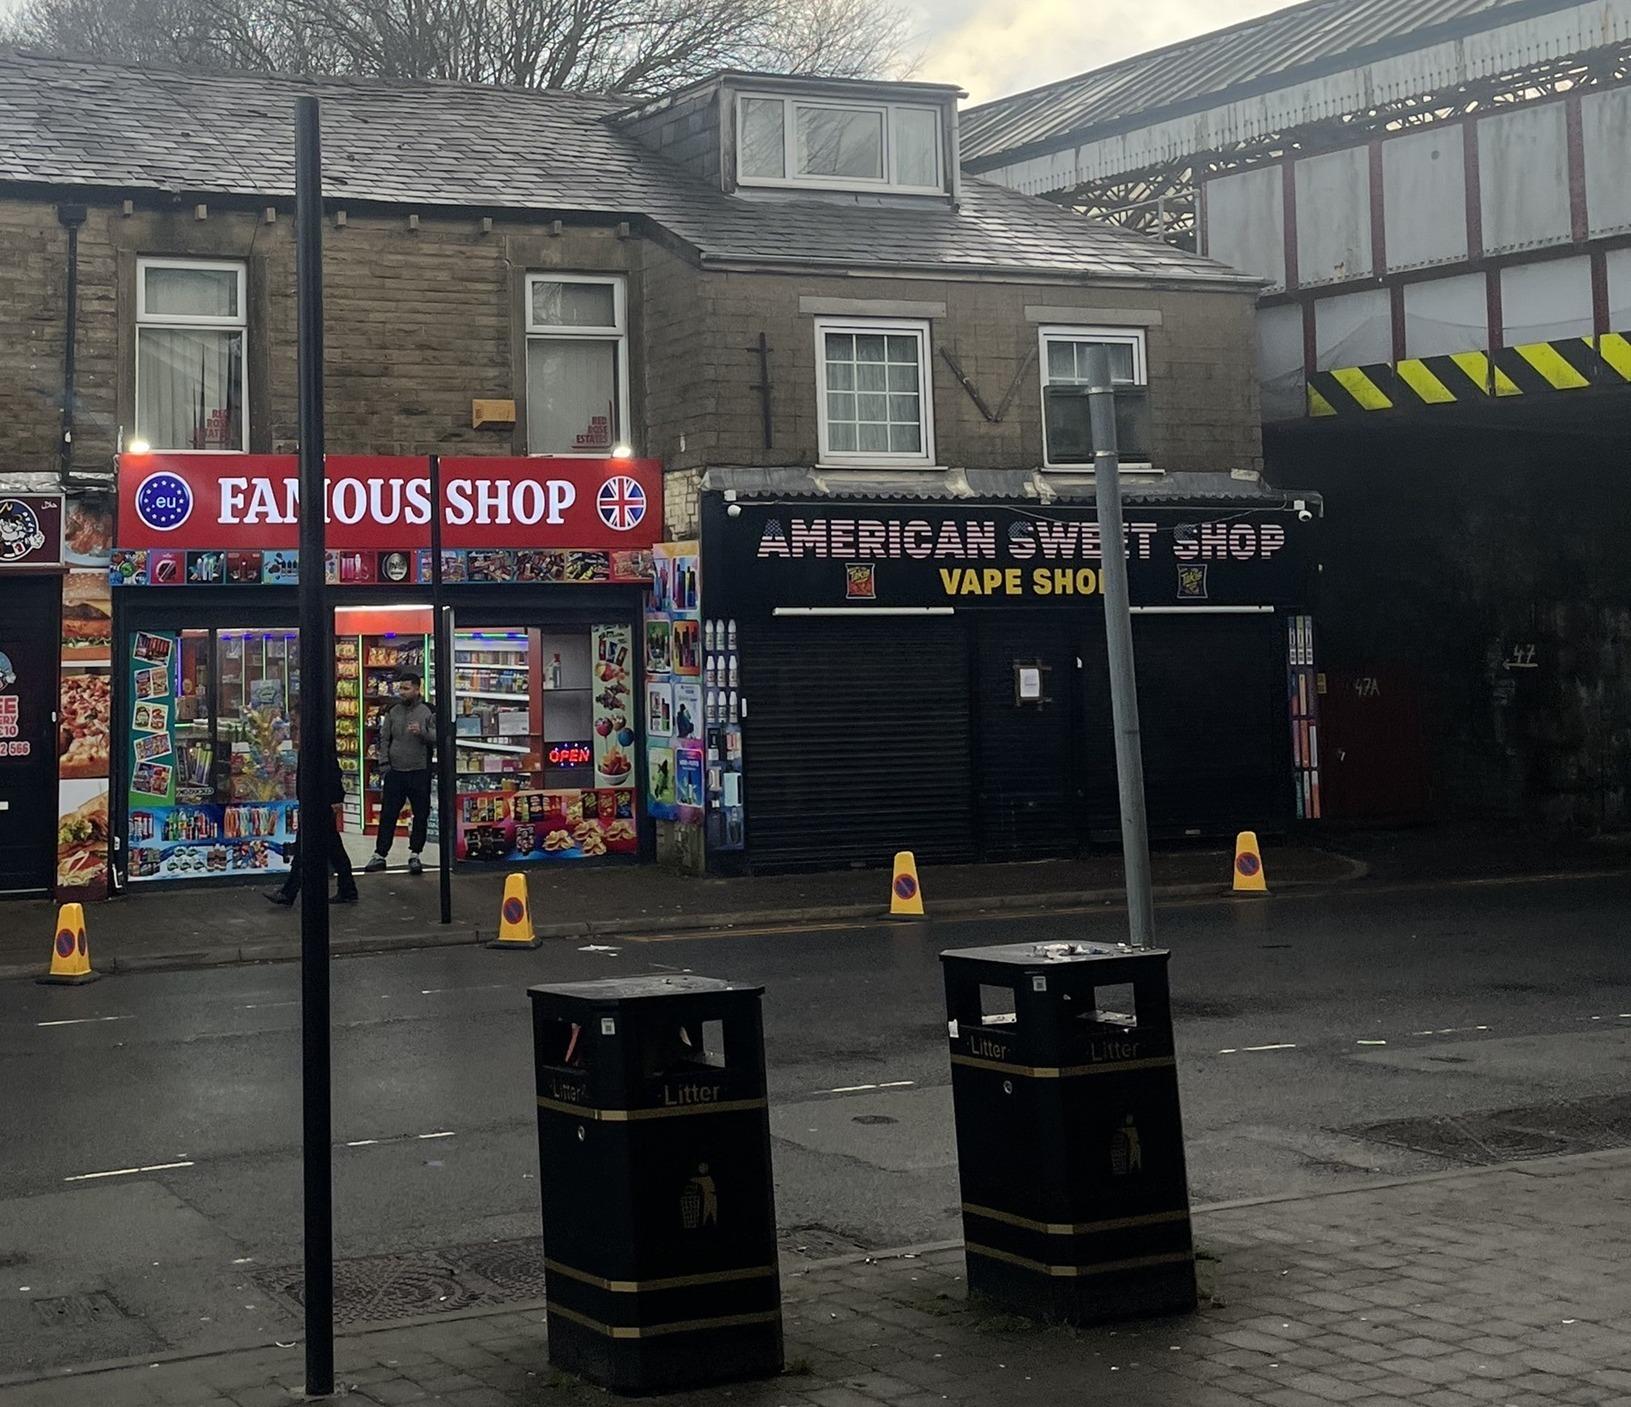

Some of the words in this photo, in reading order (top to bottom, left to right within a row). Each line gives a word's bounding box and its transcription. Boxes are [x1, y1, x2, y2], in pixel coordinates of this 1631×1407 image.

[445, 479, 577, 525] SHOP
[757, 518, 996, 559] AMERICAN
[1008, 520, 1157, 560] SWET
[1173, 522, 1285, 560] SHOP
[939, 568, 1023, 596] VAPE
[1033, 568, 1105, 596] SHO
[1355, 678, 1380, 696] 47A
[549, 748, 590, 763] OPEN
[970, 1035, 1008, 1060] Litter
[1091, 1041, 1139, 1062] Litter
[664, 1083, 720, 1105] Litter
